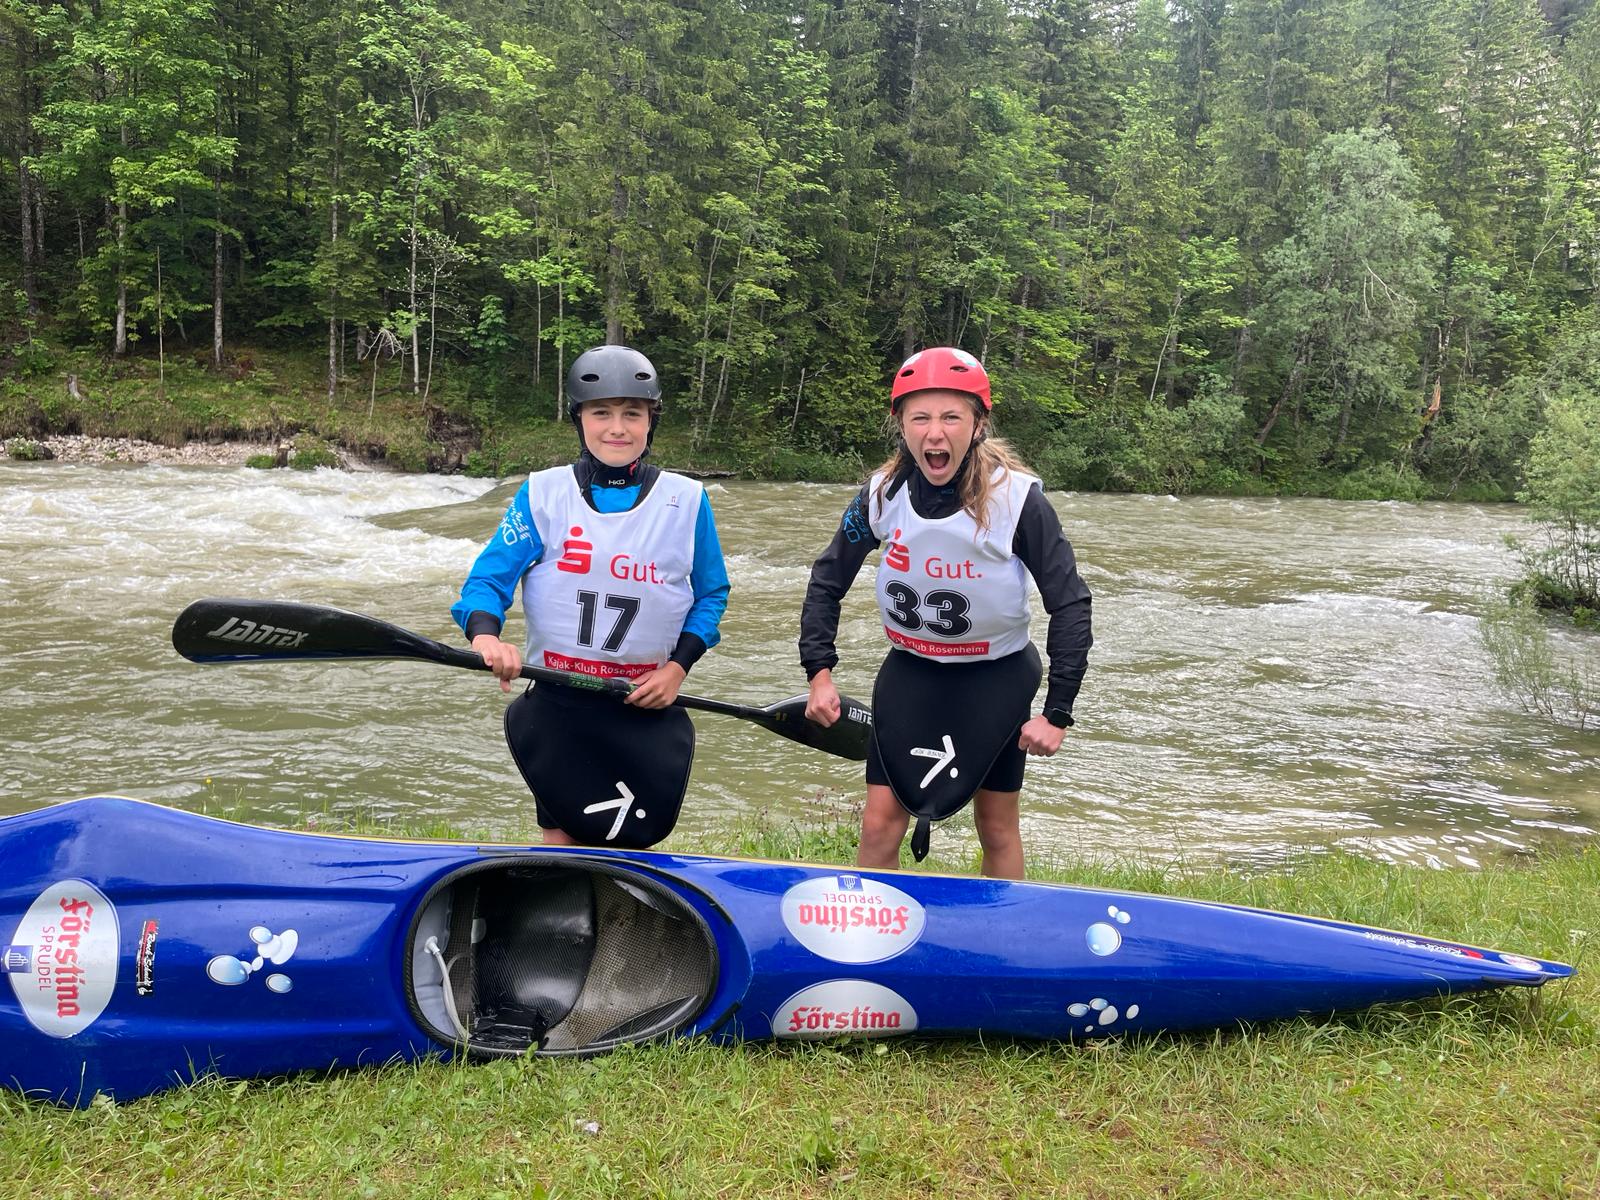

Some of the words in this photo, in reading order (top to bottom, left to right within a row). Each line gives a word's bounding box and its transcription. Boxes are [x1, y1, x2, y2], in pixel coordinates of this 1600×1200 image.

[610, 554, 665, 585] Gut.
[925, 557, 983, 579] Gut.
[576, 589, 641, 652] 17
[885, 580, 972, 638] 33
[547, 655, 598, 674] Kajak-Klub
[929, 644, 985, 654] Rosenheim
[822, 893, 882, 905] SPRUDEL
[799, 904, 909, 935] Förstina
[36, 926, 55, 992] SPRUDEL
[55, 896, 94, 1018] Förstina
[788, 1006, 902, 1032] Förstina
